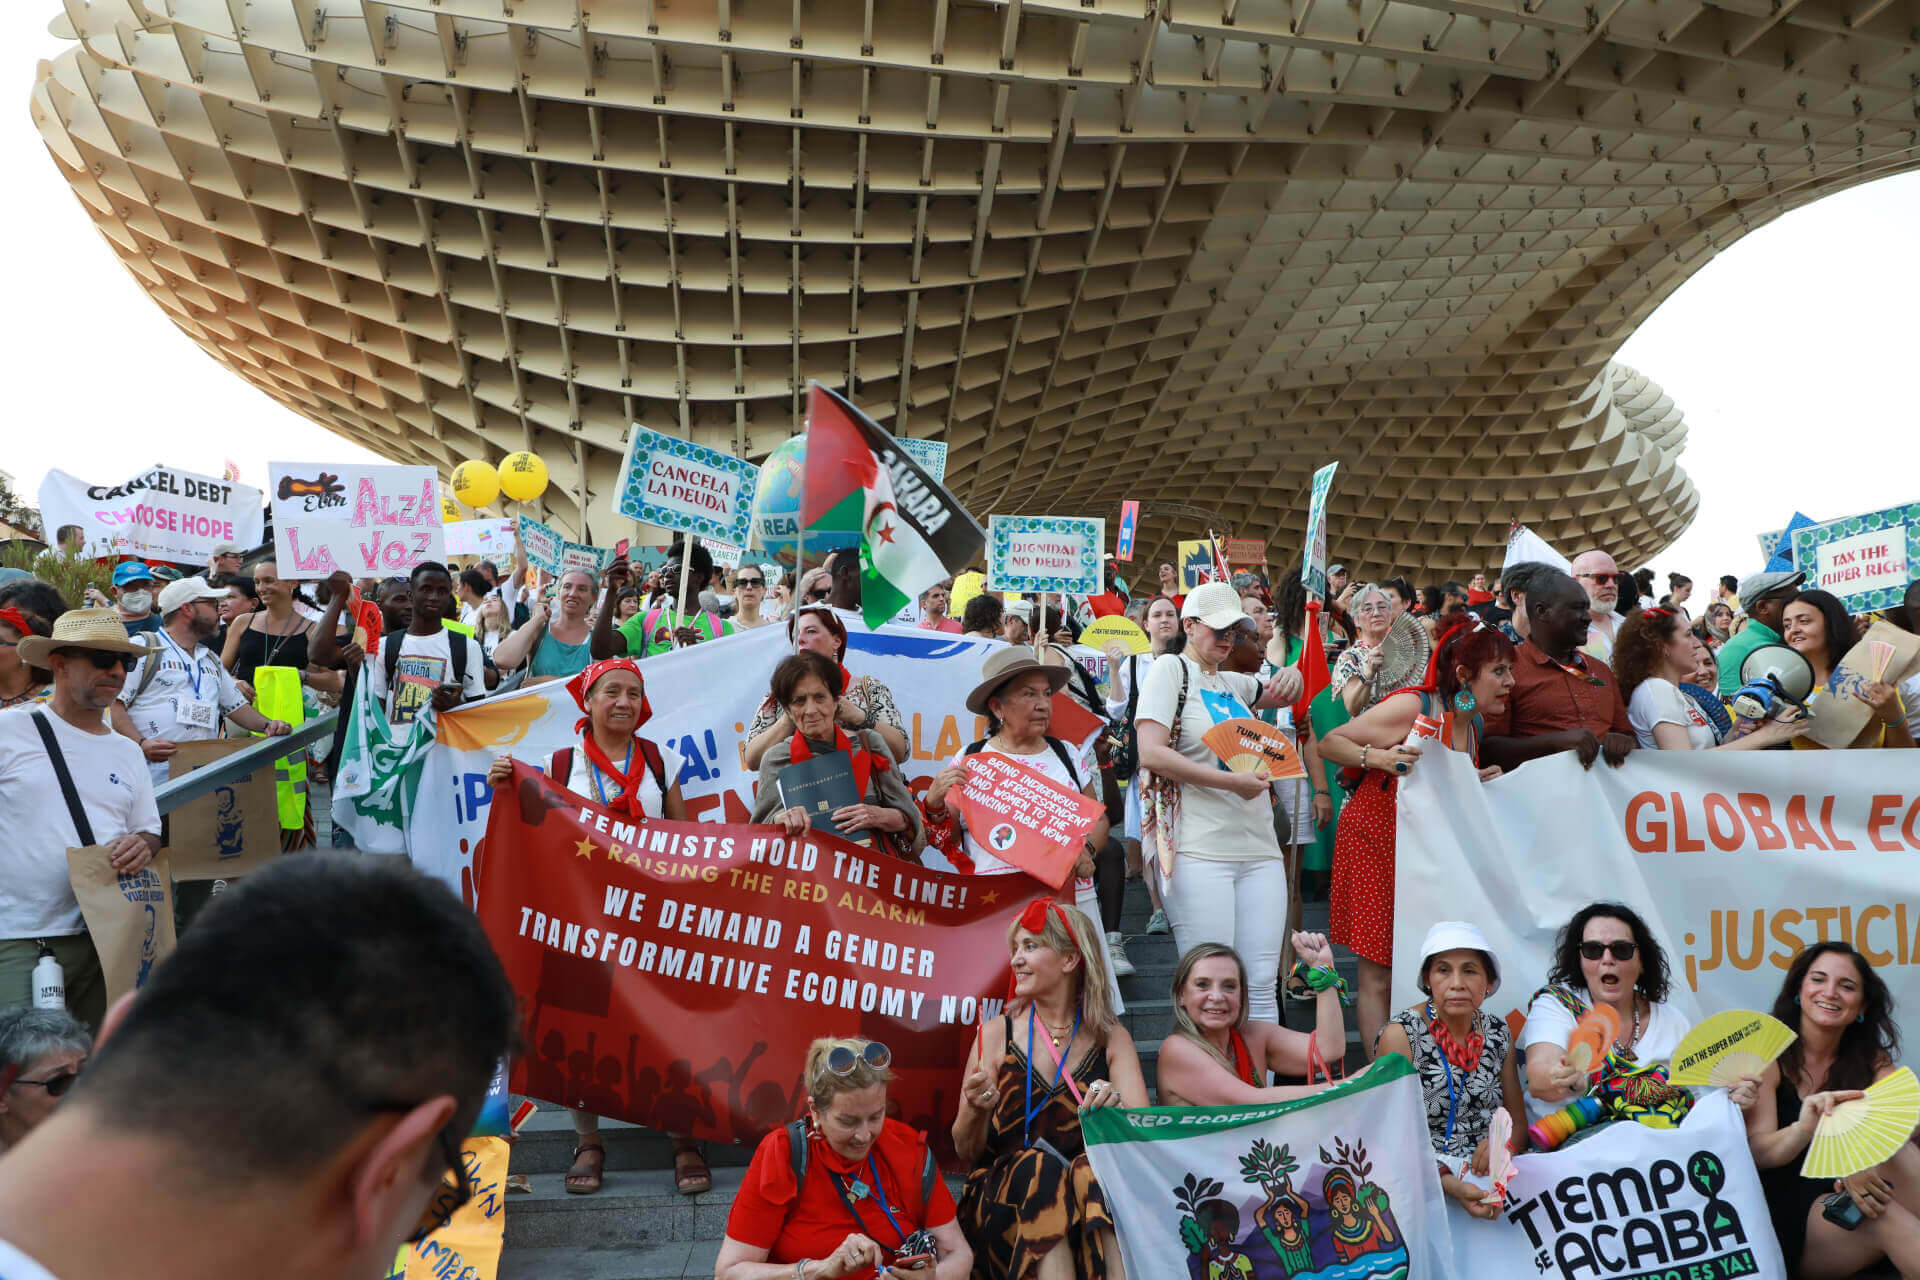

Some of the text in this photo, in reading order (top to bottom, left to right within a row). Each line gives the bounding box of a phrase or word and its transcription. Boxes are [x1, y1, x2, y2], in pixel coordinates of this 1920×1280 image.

[87, 471, 232, 505] CANCEL DEBT
[647, 479, 727, 513] LA DEUDA
[652, 461, 729, 496] CANCELA
[94, 503, 234, 541] CHOOSE HOPE
[351, 478, 442, 528] ALZA
[763, 518, 800, 536] REA
[285, 527, 341, 575] LA
[359, 531, 433, 571] VOZ
[1012, 556, 1072, 569] NO DEUD
[1832, 544, 1888, 568] TAX THE
[1821, 561, 1906, 586] SUPER RICH
[1235, 725, 1285, 750] TURN DEBT
[1239, 738, 1264, 752] INTO
[962, 783, 1012, 815] INANCING
[966, 759, 1092, 828] RURAL AFRODESCENDENT
[969, 776, 1070, 831] AND WOMEN TO THE
[987, 758, 1080, 812] BRING INDIGENOUS
[1625, 791, 1857, 854] GLOBAL
[579, 807, 969, 909] FEMINISTS HOLD THE LINE!
[607, 843, 926, 927] RAISING THE RED ALARM
[603, 884, 936, 978] WE DEMAND A GENDER
[1684, 903, 1920, 992] ¡JUSTICI
[518, 906, 772, 996] TRANSFORMATIVE
[785, 968, 925, 1021] ECONOMY
[1696, 1048, 1708, 1061] THE
[1707, 1038, 1729, 1056] SUPER
[1728, 1030, 1745, 1046] RICH
[1125, 1113, 1173, 1128] RED
[1508, 1150, 1725, 1250] TIEMPO
[1534, 1200, 1748, 1280] SE ACABA
[1719, 1252, 1753, 1276] YA!
